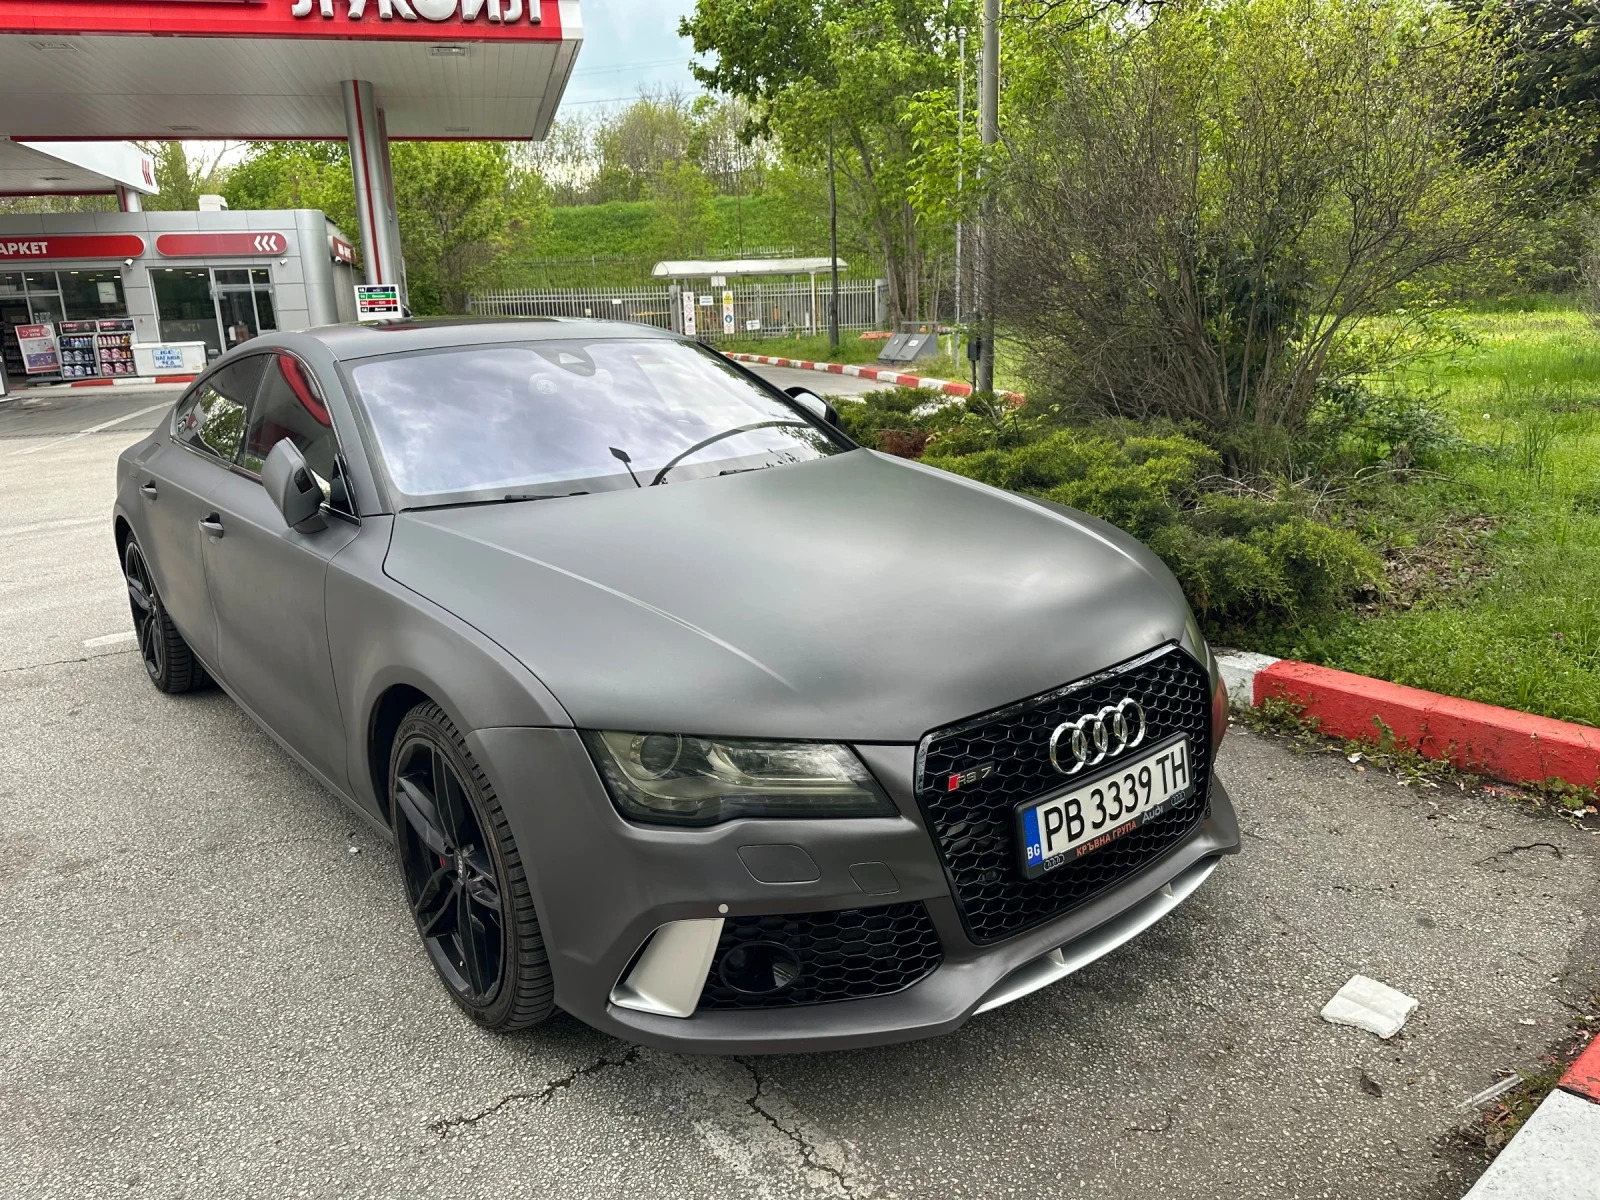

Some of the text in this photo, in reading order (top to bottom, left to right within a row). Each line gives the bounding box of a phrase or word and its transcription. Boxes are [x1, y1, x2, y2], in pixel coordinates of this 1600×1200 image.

[1043, 746, 1187, 852] PB 3339 TH
[1141, 806, 1164, 825] Audi
[1026, 843, 1041, 860] BG
[1076, 820, 1137, 857] КРЪВНА ГРУПА
